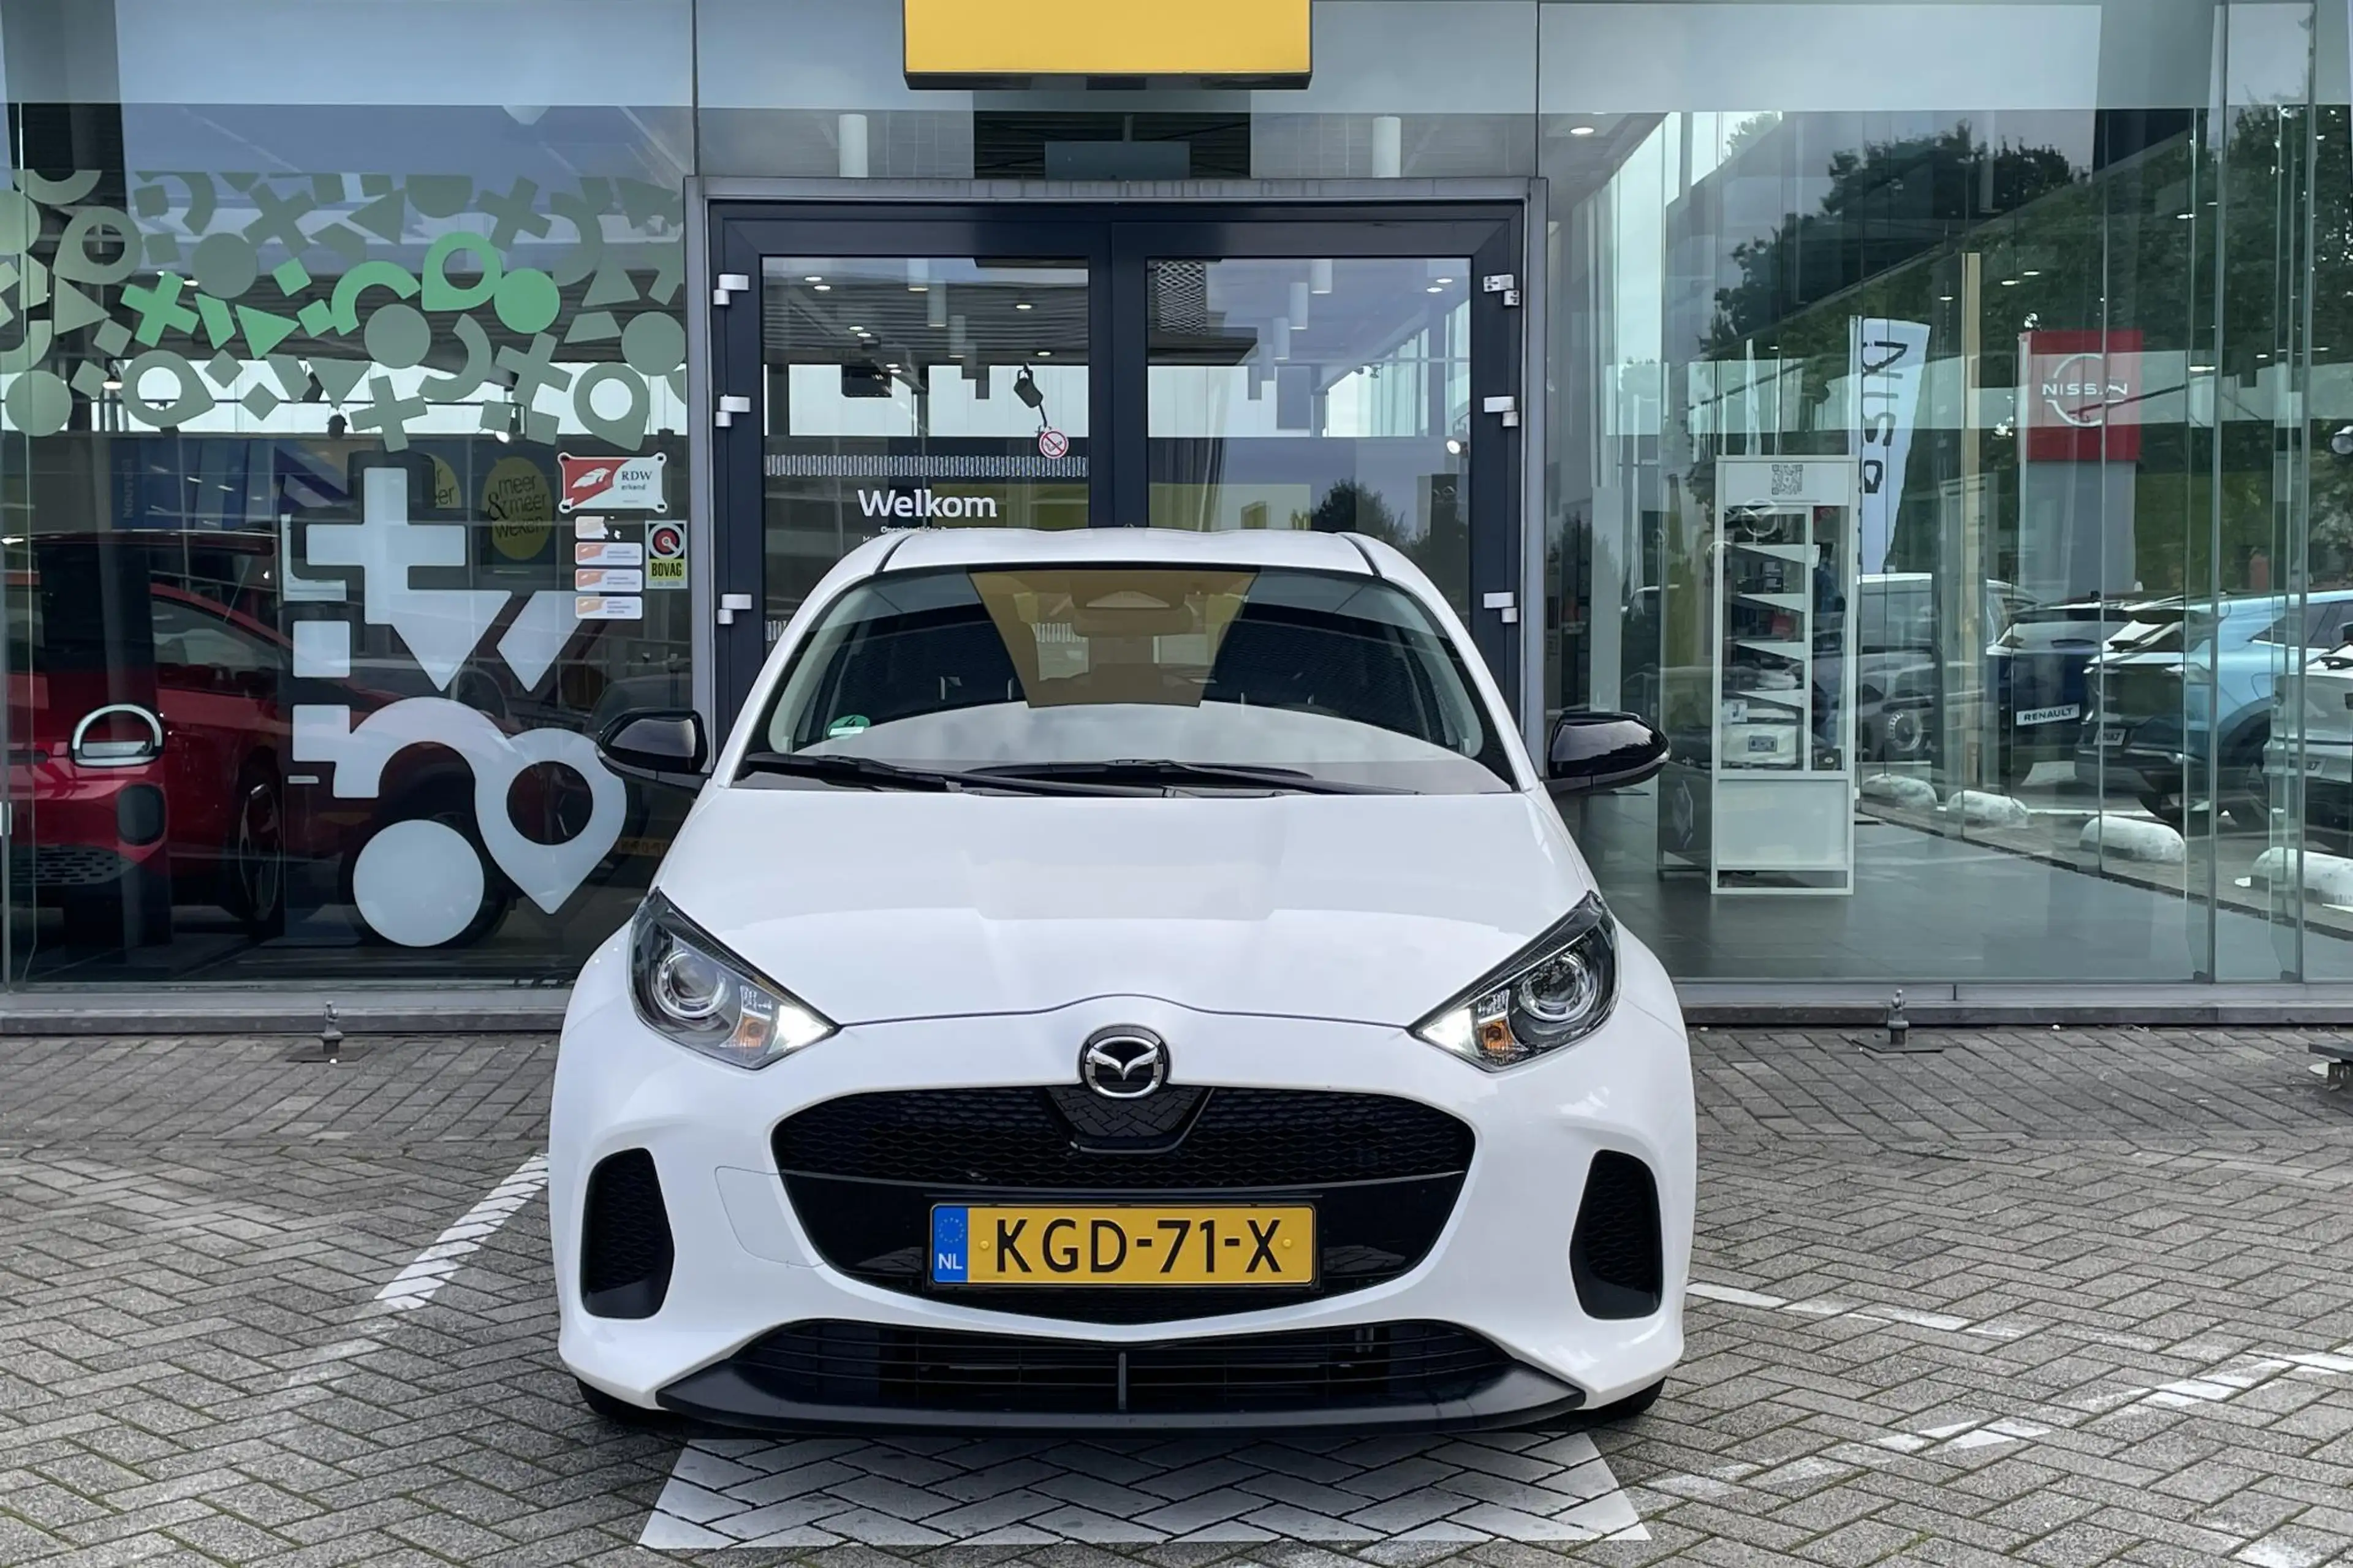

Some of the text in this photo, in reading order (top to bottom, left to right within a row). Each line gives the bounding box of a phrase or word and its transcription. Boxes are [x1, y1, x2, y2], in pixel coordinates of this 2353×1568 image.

[2042, 382, 2128, 396] NISSN
[621, 470, 653, 481] RDW
[498, 475, 536, 496] meer
[858, 489, 998, 518] Welkom
[651, 562, 682, 577] BOVAG
[2024, 707, 2074, 721] RENAULT
[996, 1218, 1282, 1273] KGD-71-X
[938, 1253, 963, 1270] NL
